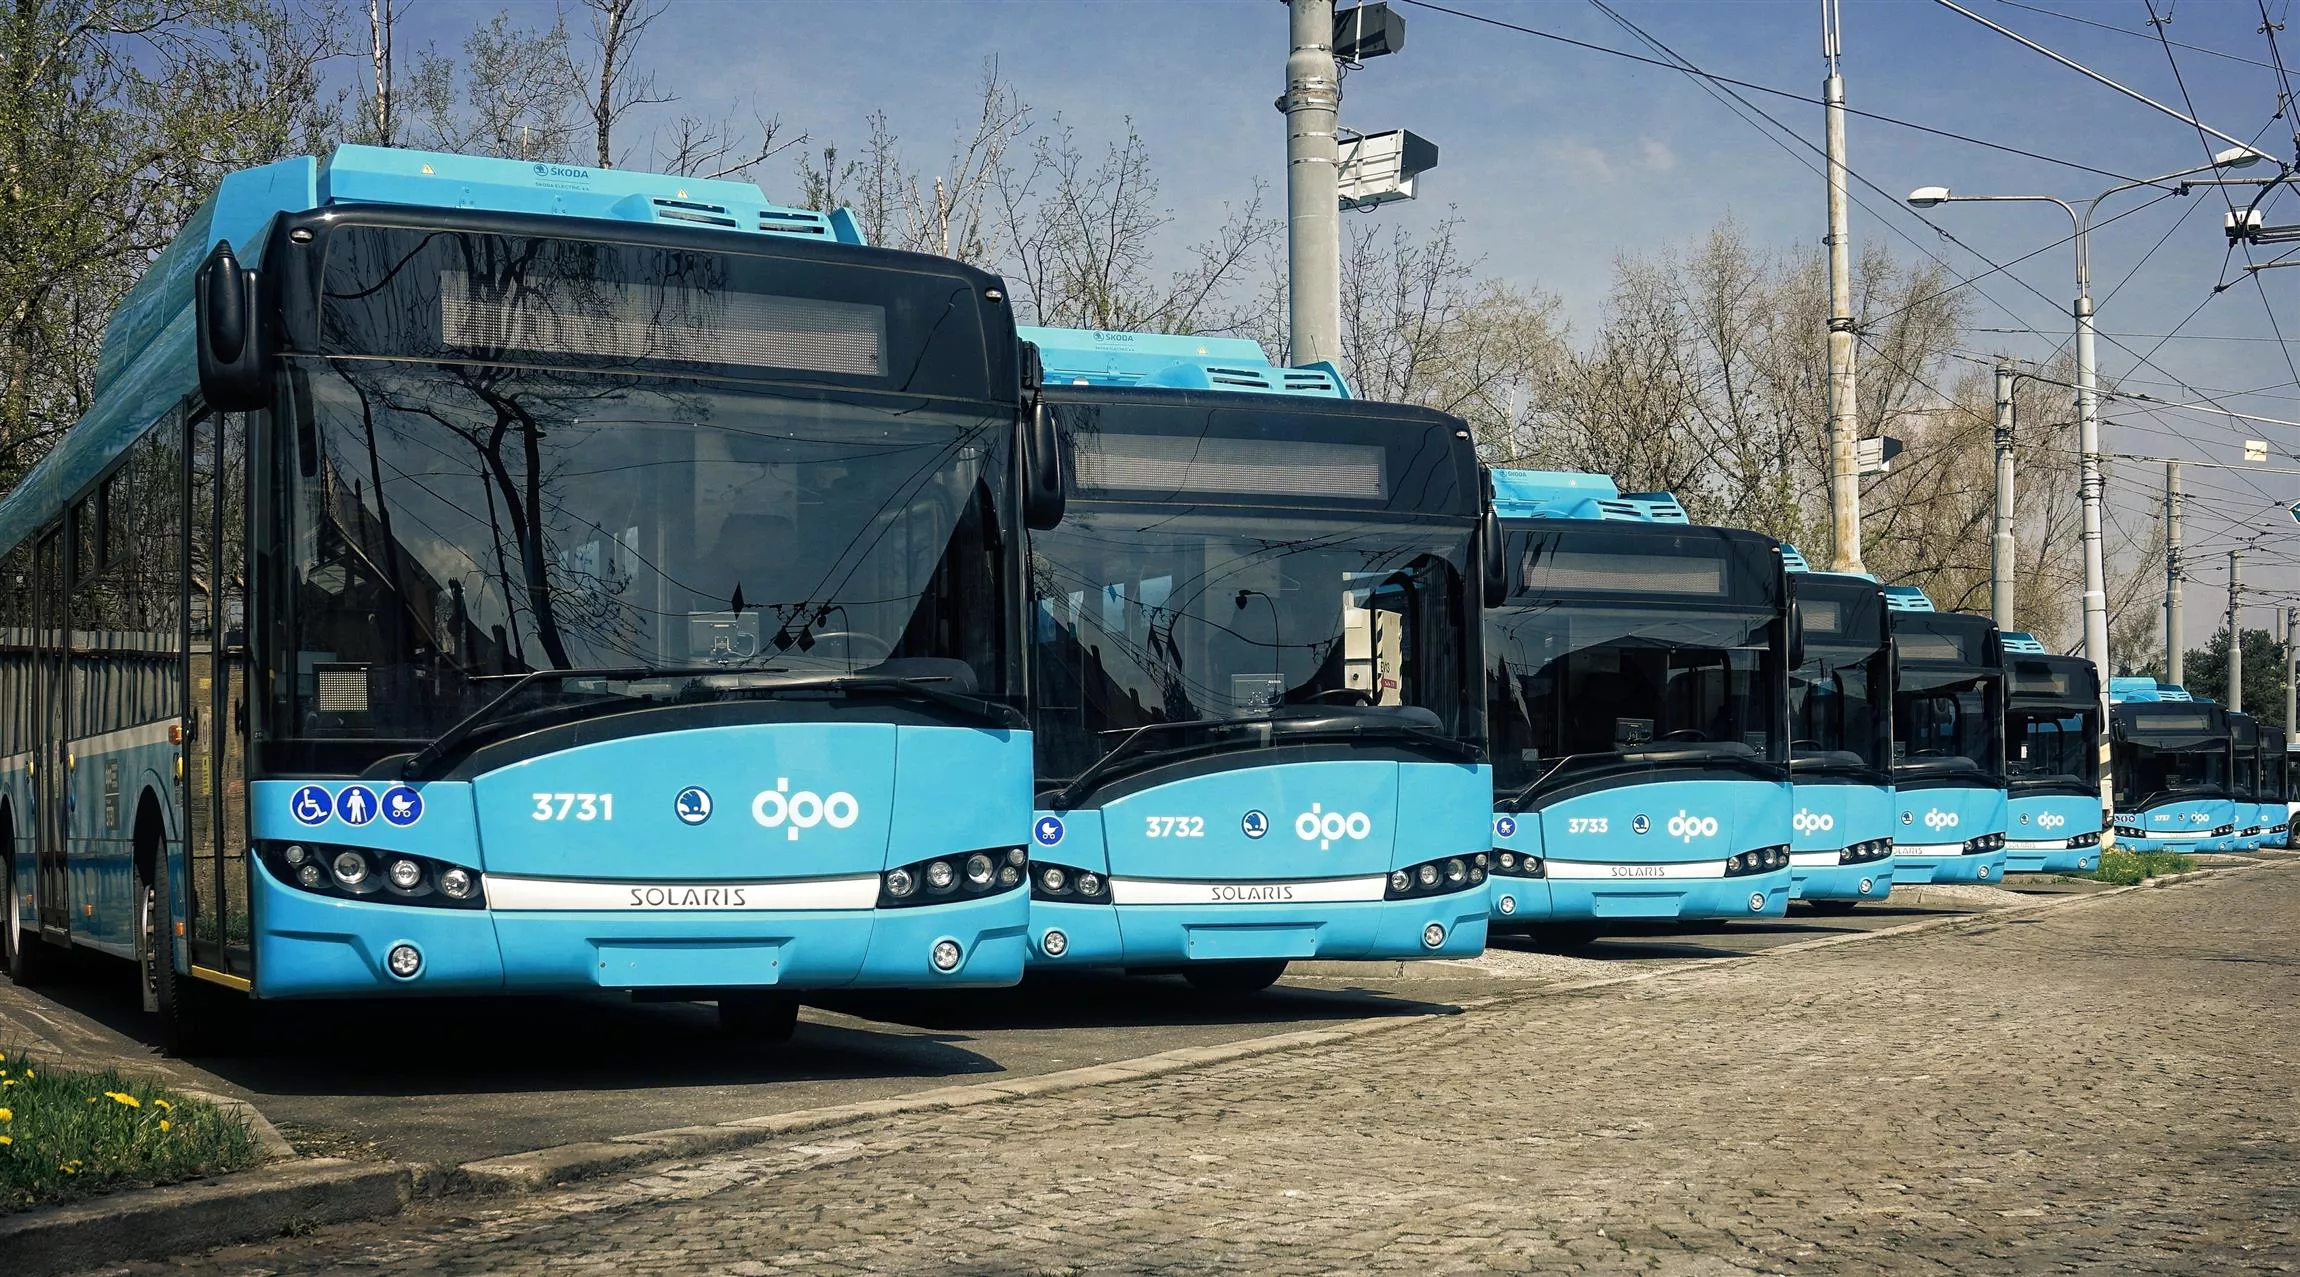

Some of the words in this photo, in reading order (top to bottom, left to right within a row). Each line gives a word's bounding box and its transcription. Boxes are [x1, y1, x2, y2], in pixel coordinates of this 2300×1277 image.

[551, 166, 589, 178] ŠKODA
[532, 793, 613, 821] 3731
[752, 777, 859, 841] dpo
[1146, 816, 1204, 838] 3732
[1295, 803, 1371, 850] dpo
[1568, 818, 1609, 833] 3733
[1667, 809, 1718, 843] dpo
[1793, 808, 1834, 836] dpo
[1925, 808, 1959, 832] dpo
[2038, 811, 2065, 830] dpo
[1611, 866, 1665, 877] SOLARIS
[630, 888, 746, 906] SOLARIS
[1211, 886, 1293, 900] SOLARIS
